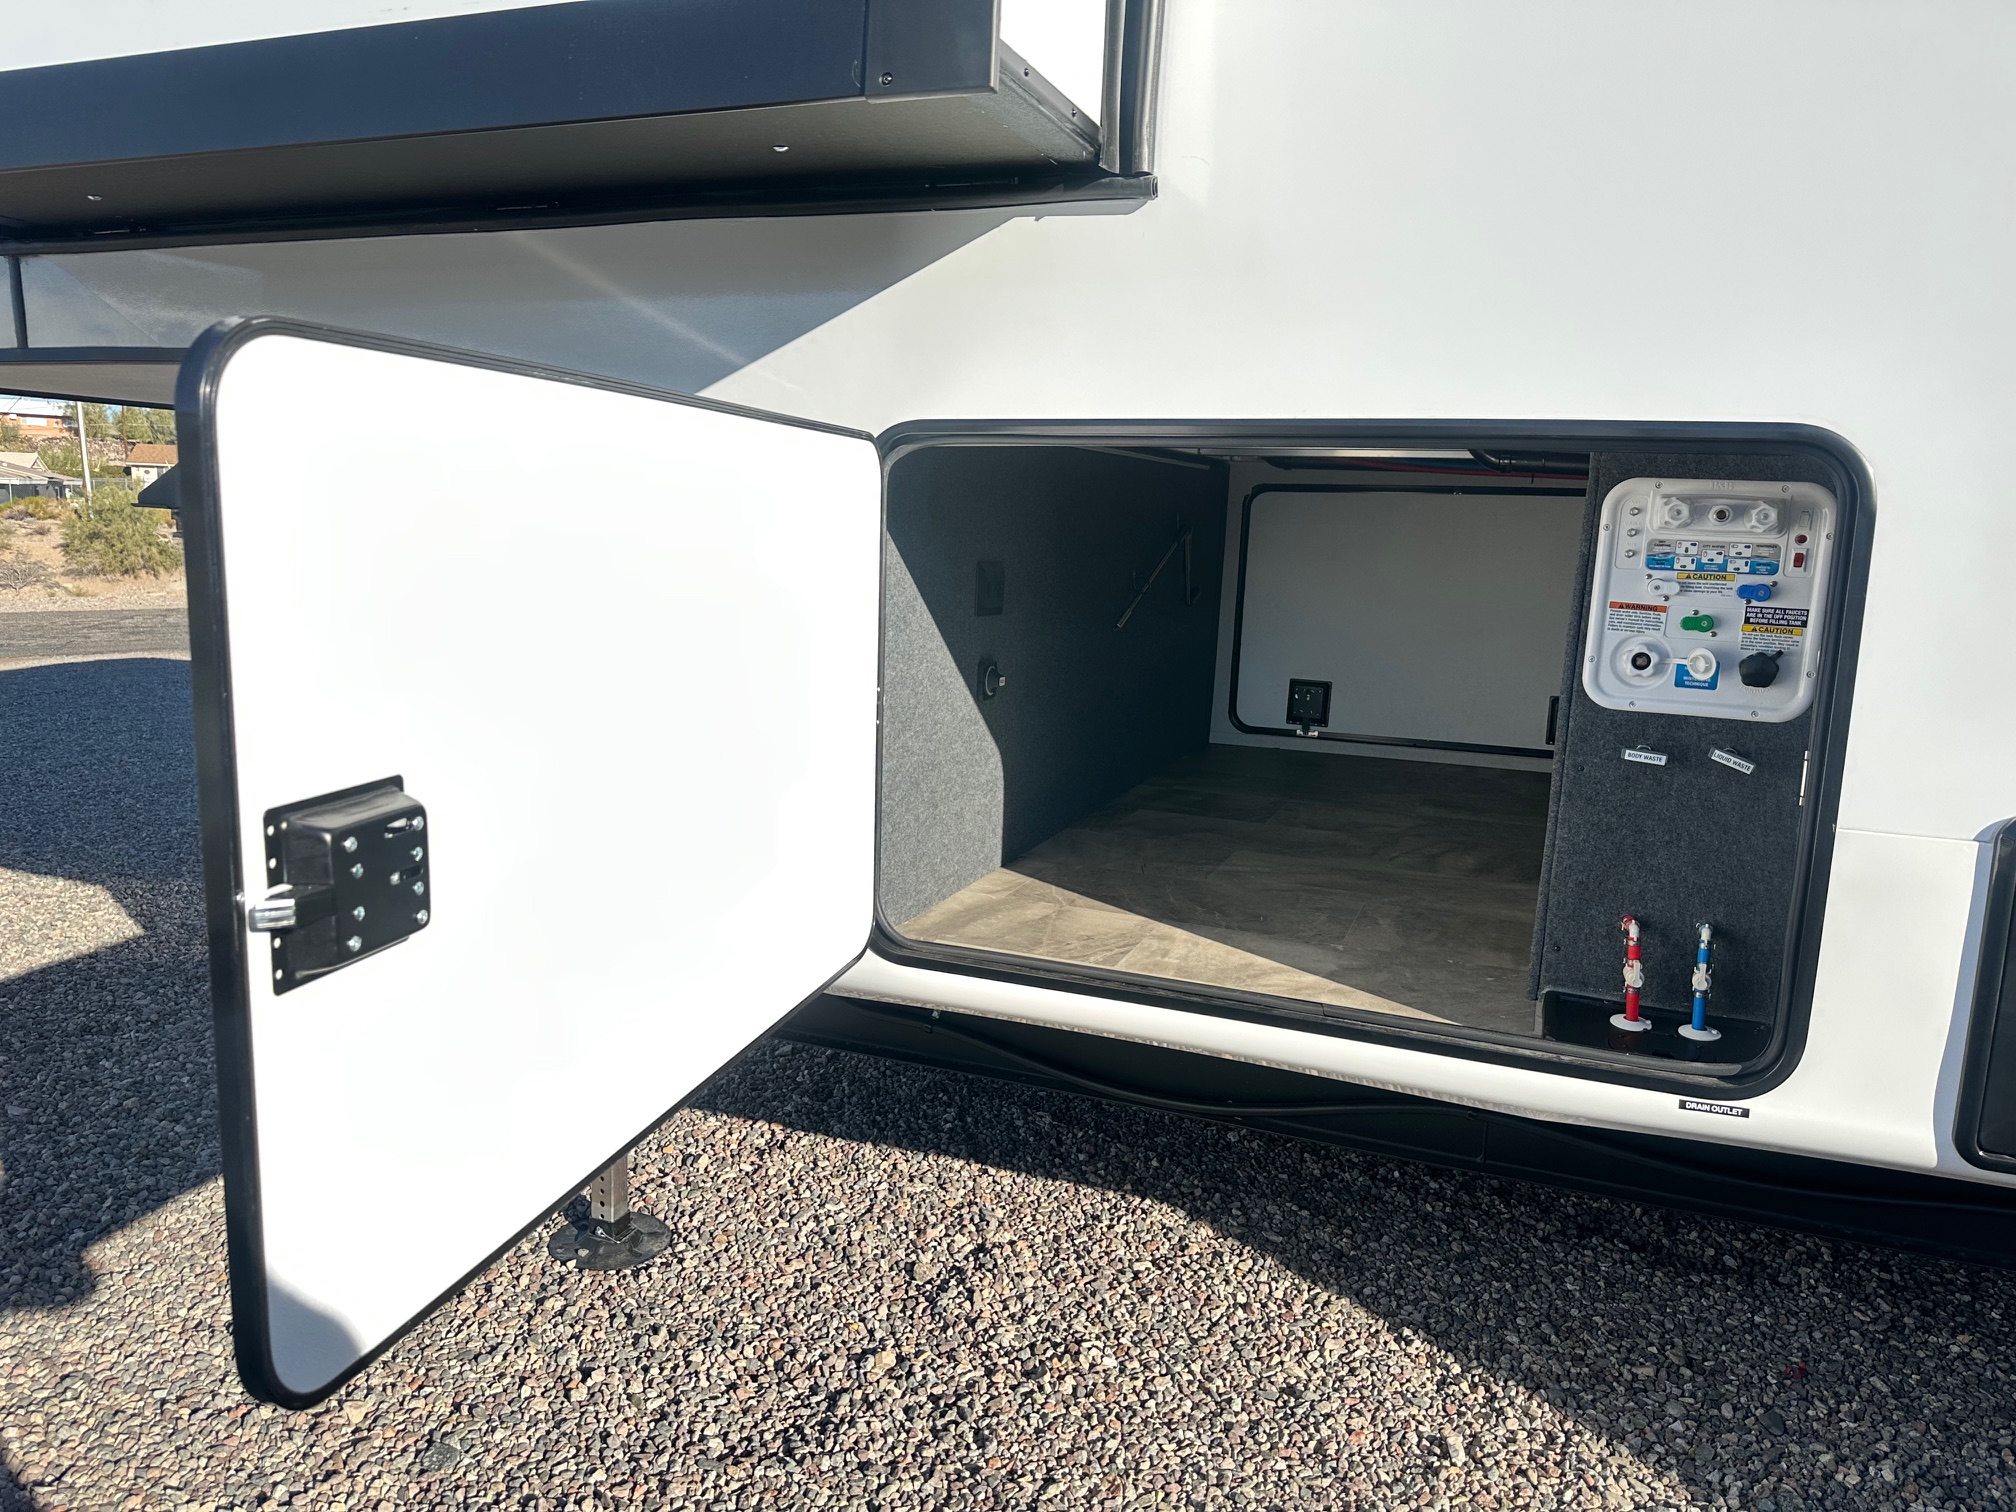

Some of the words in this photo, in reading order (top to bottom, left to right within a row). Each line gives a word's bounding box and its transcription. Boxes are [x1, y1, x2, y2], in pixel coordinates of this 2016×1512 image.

[1692, 573, 1727, 581] CAUTION
[1625, 603, 1658, 611] WARNING
[1758, 626, 1794, 635] CAUTION
[1643, 754, 1663, 762] WASTE
[1713, 751, 1732, 763] LIQUID
[1732, 760, 1752, 772] WASTE
[1685, 1101, 1710, 1112] DRAIN
[1711, 1105, 1743, 1116] OUTLET
